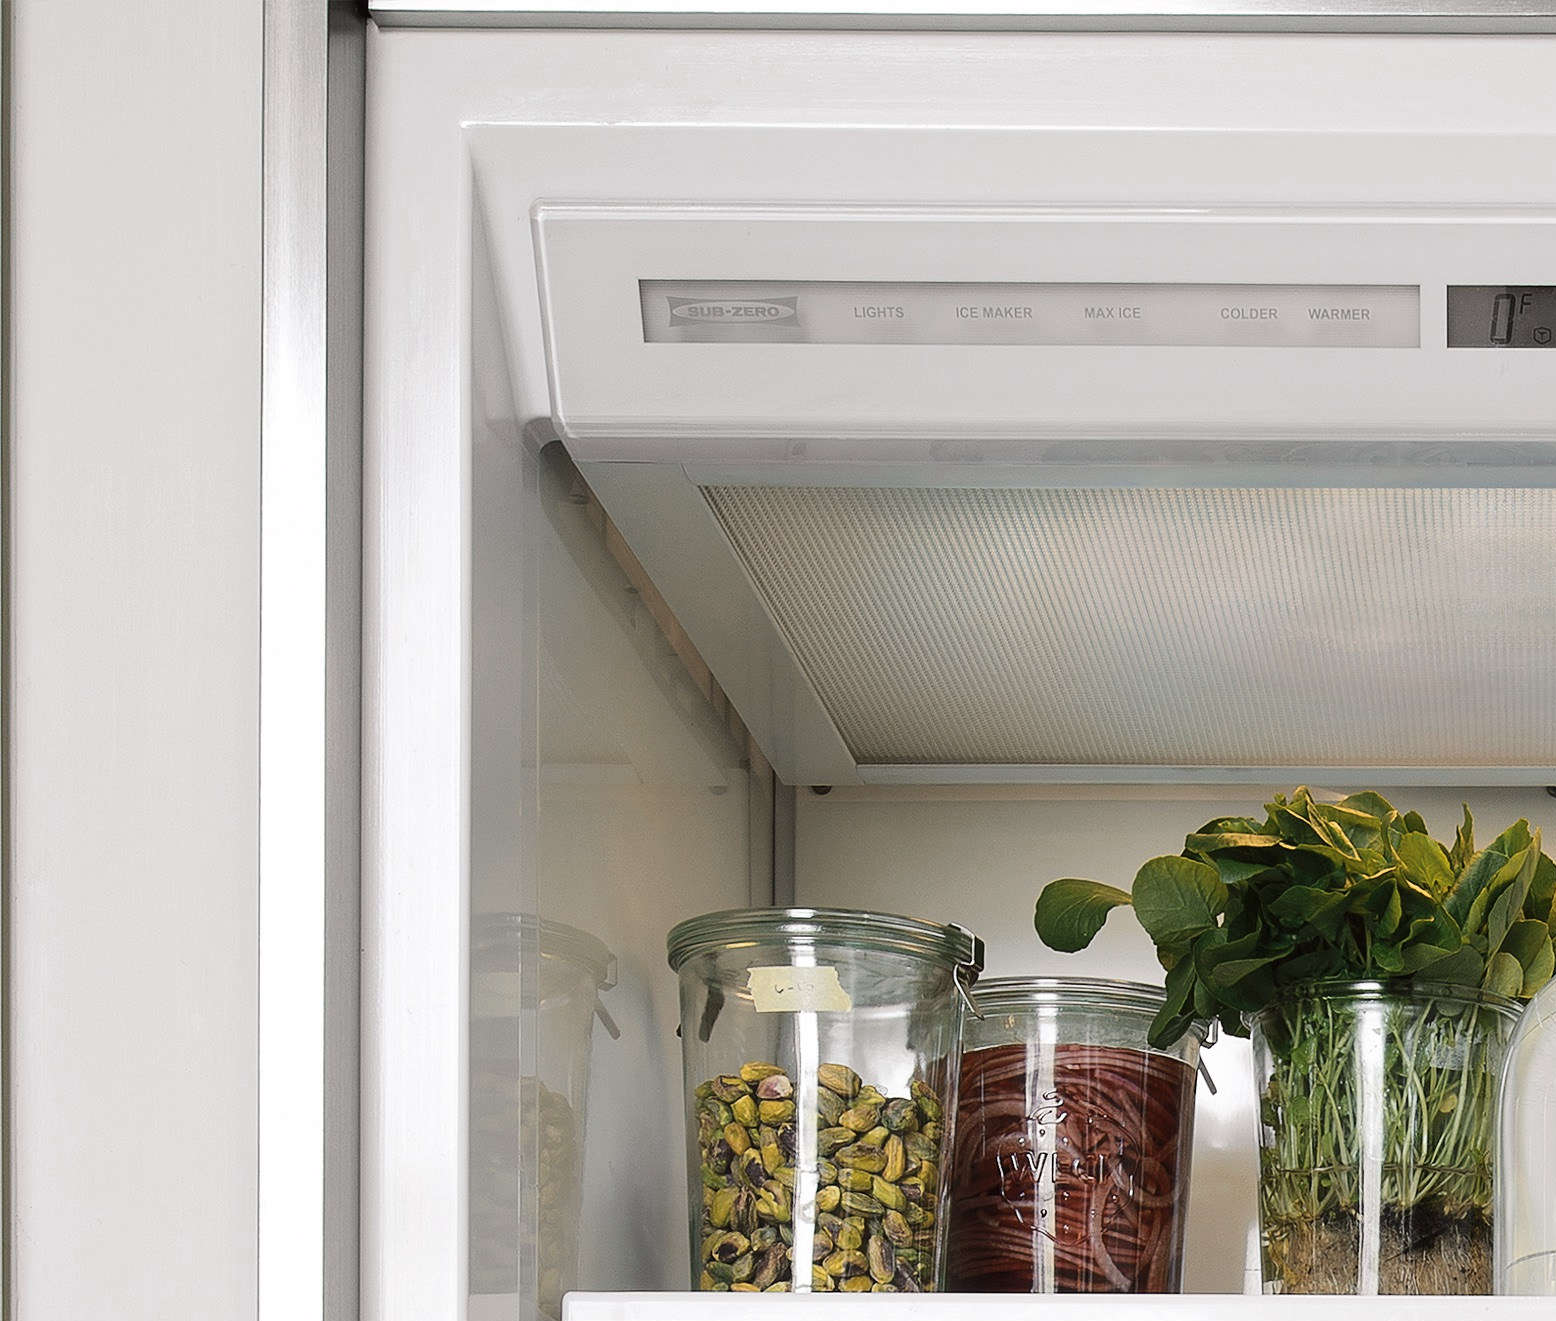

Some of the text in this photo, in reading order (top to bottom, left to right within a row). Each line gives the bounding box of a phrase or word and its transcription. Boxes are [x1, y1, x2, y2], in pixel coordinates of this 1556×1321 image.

[687, 304, 780, 319] SUB-ZERO
[853, 305, 905, 320] LIGHTS
[955, 306, 1033, 320] ICE MAKER
[1084, 307, 1142, 319] MAX ICE
[1220, 308, 1279, 320] COLDER
[1307, 308, 1371, 321] WARMER
